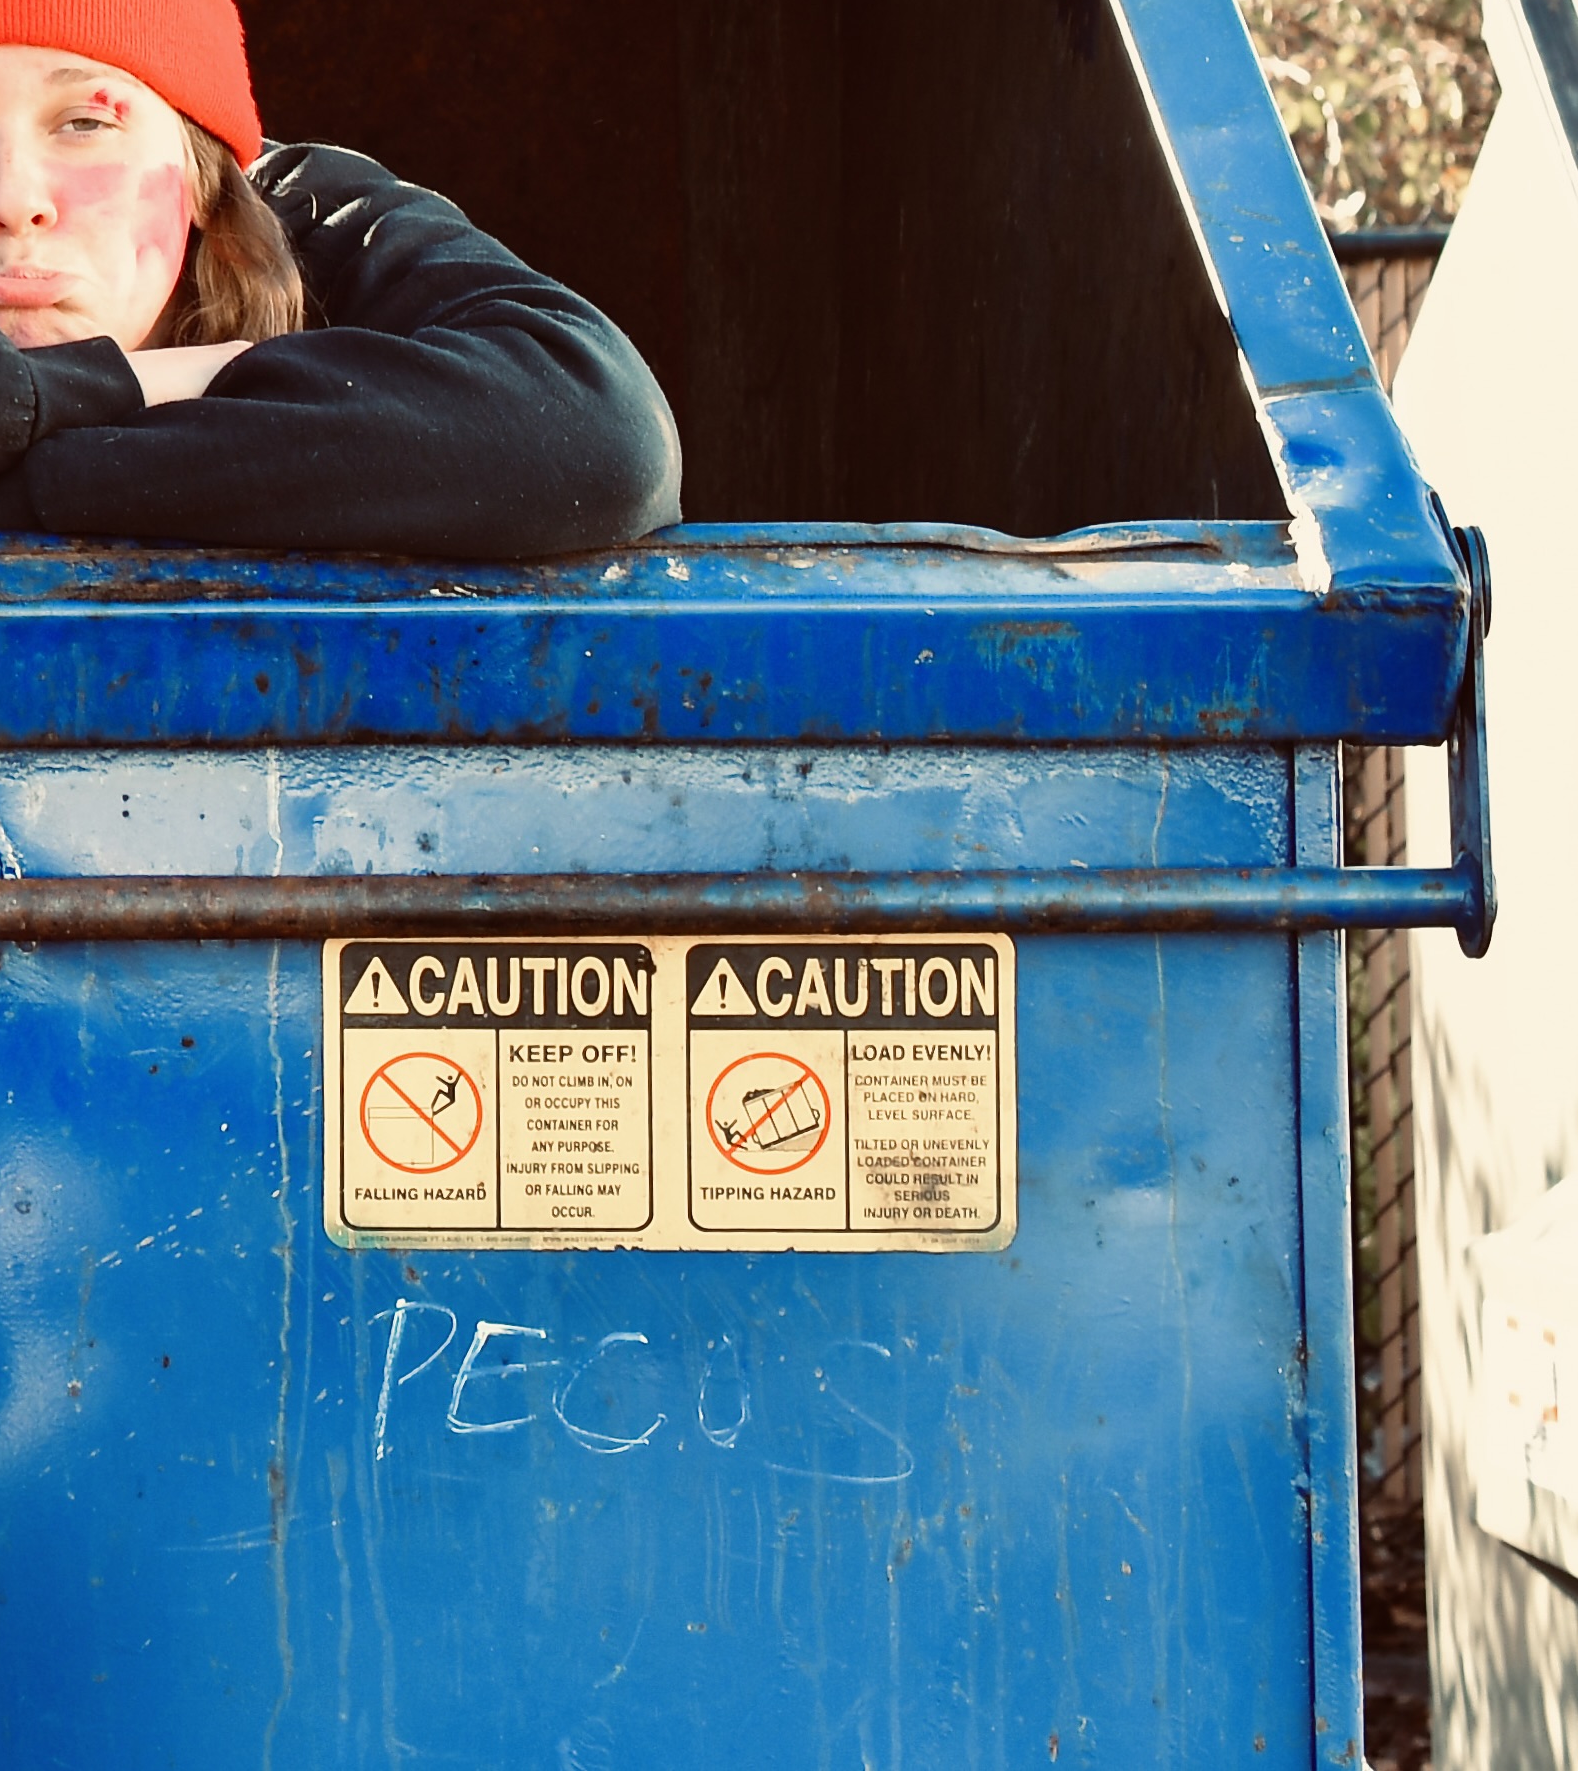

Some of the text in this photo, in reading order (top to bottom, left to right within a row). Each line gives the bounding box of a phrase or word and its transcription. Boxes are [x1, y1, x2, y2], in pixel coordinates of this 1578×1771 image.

[408, 955, 649, 1017] CAUTION
[756, 956, 996, 1018] CAUTION
[509, 1044, 636, 1063] KEEP OFF!
[851, 1044, 991, 1061] LOAD EVENLY!
[512, 1075, 528, 1087] DO
[532, 1075, 555, 1087] NOT
[558, 1075, 594, 1087] CLIMB
[615, 1075, 633, 1087] ON
[854, 1075, 987, 1087] CONTAINER MUST BE
[524, 1097, 621, 1109] OR OCCUPY THIS
[863, 1091, 980, 1105] PLACED ON HARD,
[868, 1109, 907, 1121] LEVEL
[526, 1119, 619, 1131] CONTAINER FOR
[531, 1141, 615, 1153] ANY PURPOSE.
[854, 1139, 990, 1150] TILTED OR UNEVENLY
[506, 1162, 640, 1174] INJURY FROM SLIPPING
[857, 1156, 986, 1168] LOADED CONTAINER
[865, 1173, 979, 1185] COULD RESULT IN
[354, 1188, 487, 1202] FALLING HAZARD
[524, 1184, 621, 1196] OR FALLING MAY
[699, 1187, 837, 1201] TIPPING HAZARD
[894, 1190, 951, 1202] SERIOUS
[551, 1206, 595, 1218] OCCUR.
[863, 1207, 981, 1219] INJURY OR DEATH.
